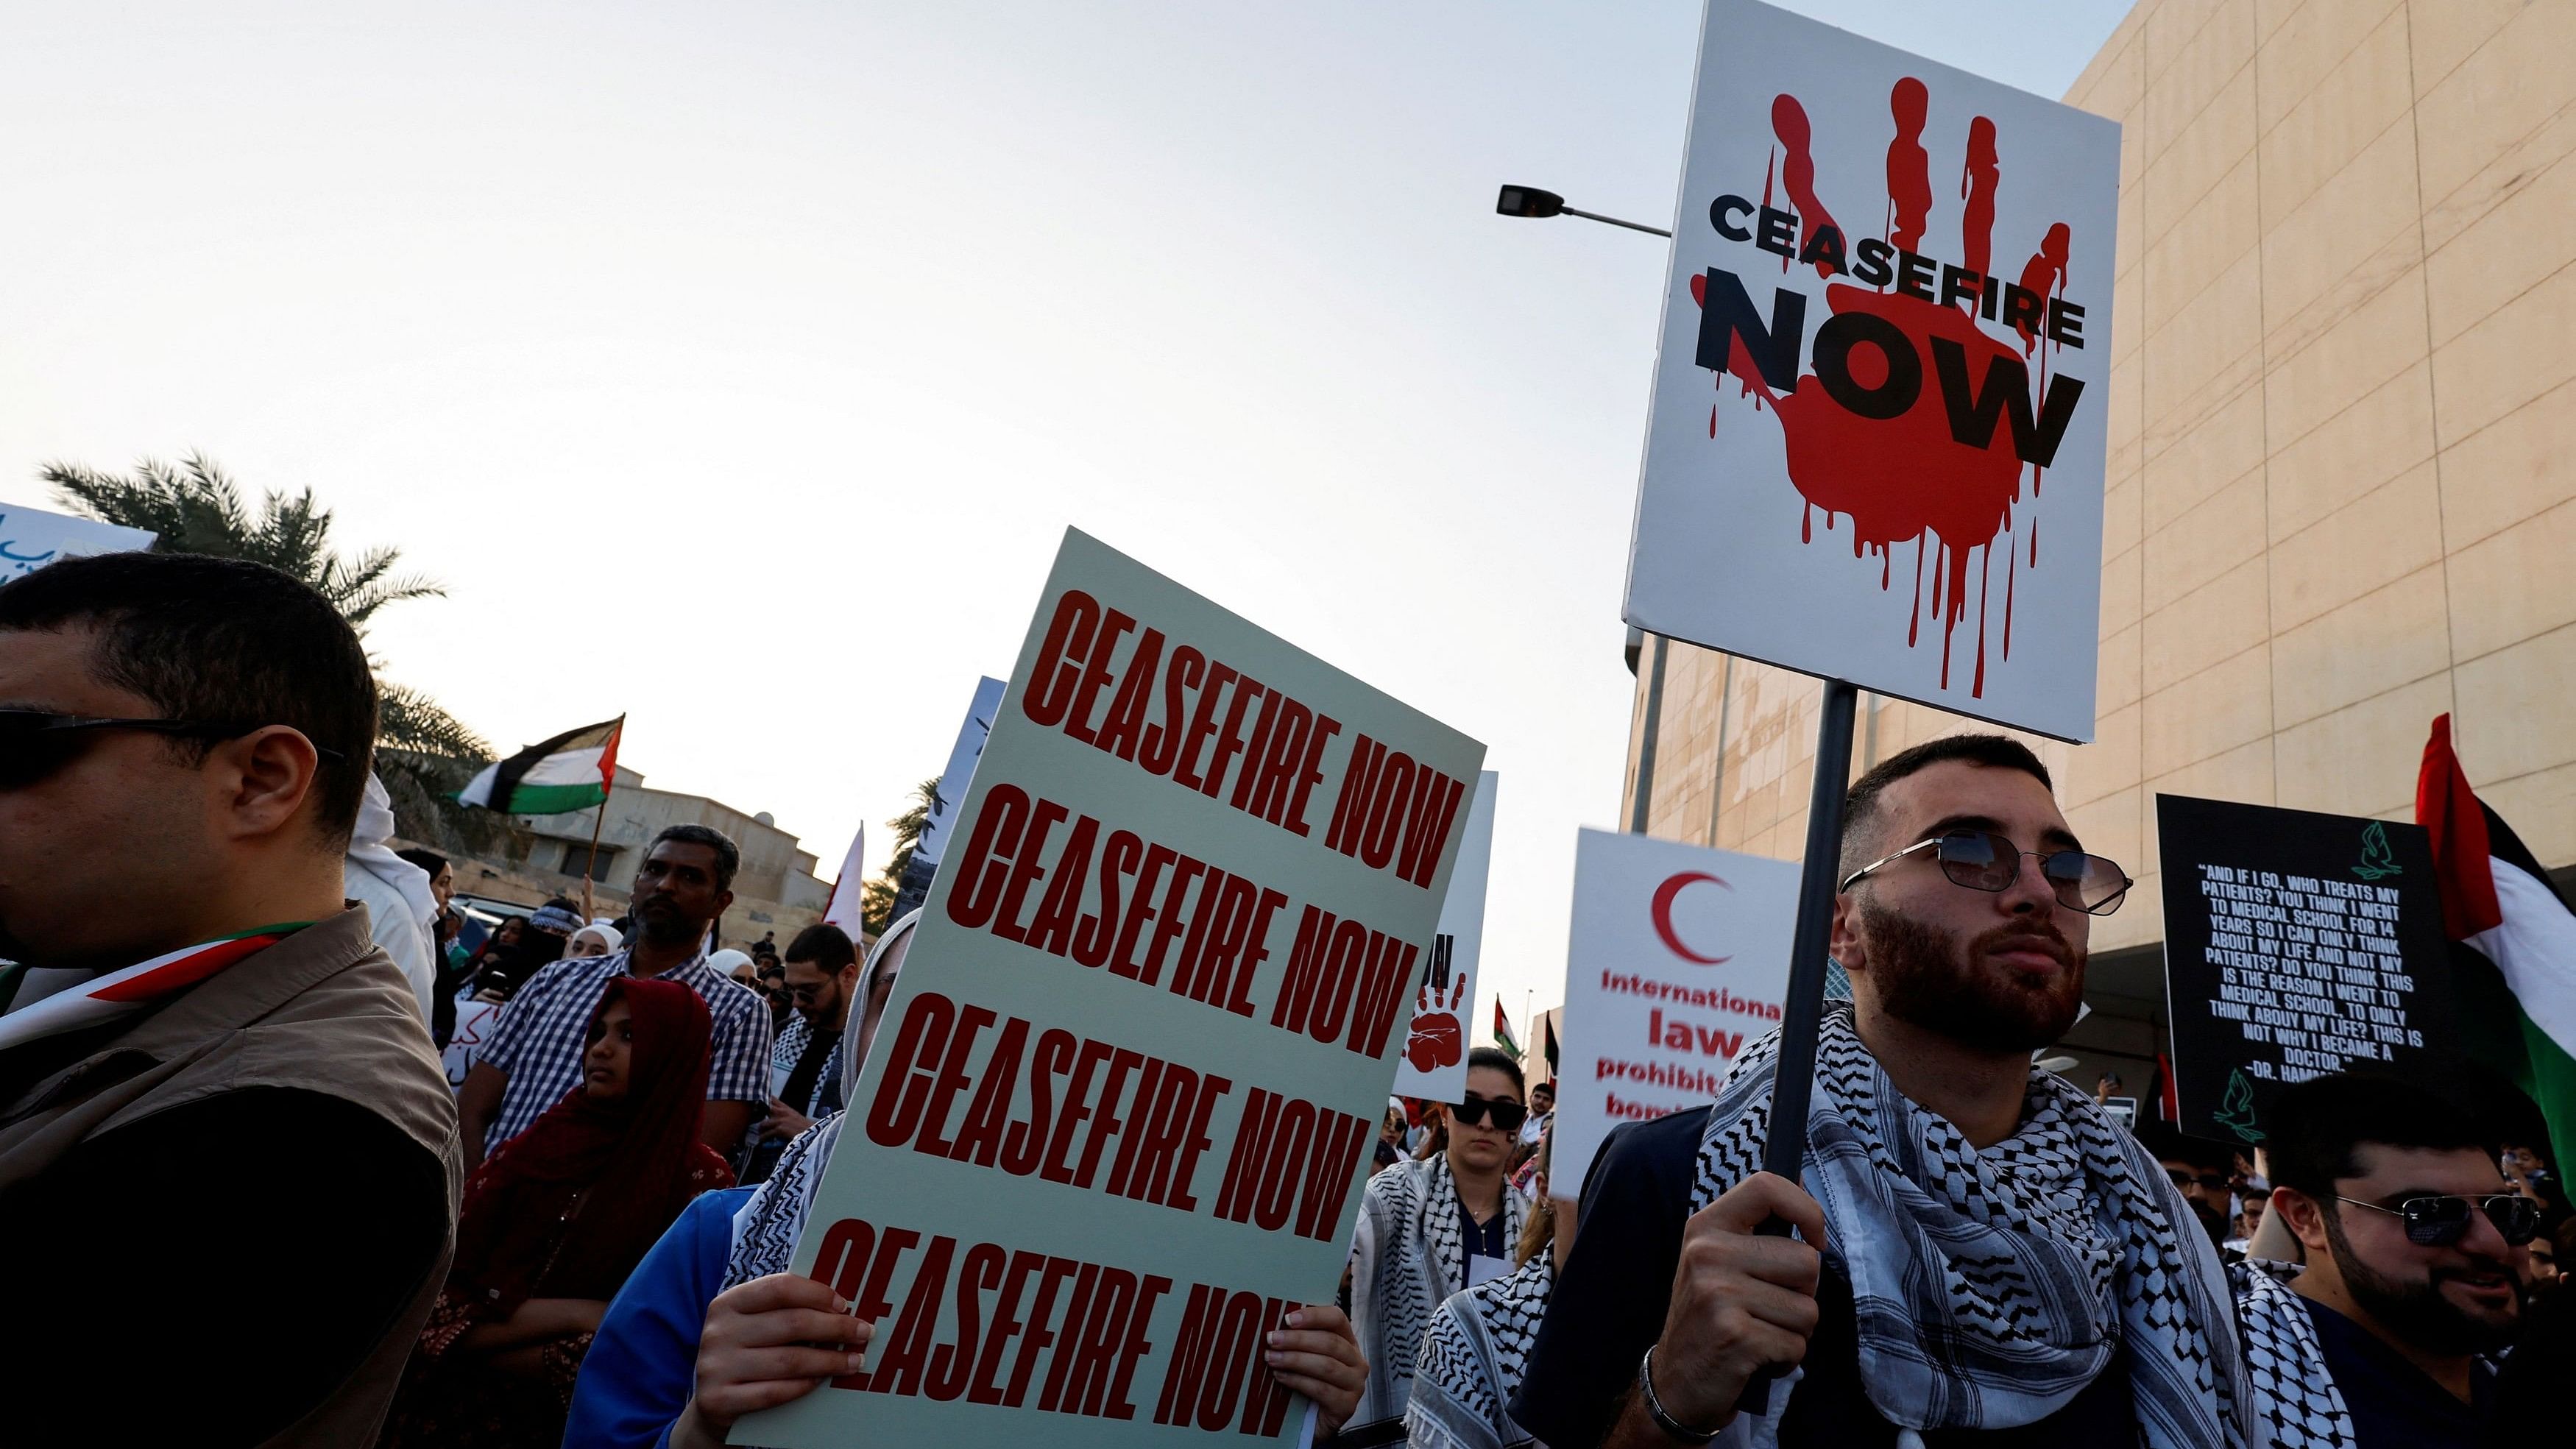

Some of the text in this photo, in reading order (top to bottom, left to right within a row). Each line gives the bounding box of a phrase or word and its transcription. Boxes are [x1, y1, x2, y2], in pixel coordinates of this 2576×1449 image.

[1710, 194, 2085, 350] CEASEFIRE
[1695, 266, 2086, 469] NOW
[1024, 591, 1465, 889] CEASEFIRE NOW
[2202, 881, 2398, 921] PATIENTS? YOU THINK I WENT
[2237, 869, 2248, 883] IF
[2253, 871, 2257, 885] I
[2261, 872, 2283, 892] GO,
[2287, 876, 2319, 893] WHO
[2323, 880, 2373, 901] TREATS
[2377, 888, 2398, 904] MY
[947, 784, 1418, 1059] CEASEFIRE NOW
[2210, 898, 2394, 937] TO MEDICAL SCHOOL FOR 14
[2210, 915, 2400, 954] YEARS SO I CAN ONLY THINK
[2206, 948, 2413, 991] PATIENTS? DO YOU THINK THIS
[2212, 932, 2401, 972] ABOUT MY LIFE AND NOT MY
[1601, 968, 1783, 1021] Internationa
[2221, 984, 2405, 1026] MEDICAL SCHOOL, TO ONLY
[2223, 967, 2399, 1007] IS THE REASON I WENT TO
[1649, 1006, 1744, 1060] law
[2209, 1000, 2422, 1046] THINK ABOUY MY LIFE? THIS IS
[2243, 1023, 2392, 1060] NOT WHY I BECAME A
[867, 993, 1370, 1241] CEASEFIRE NOW
